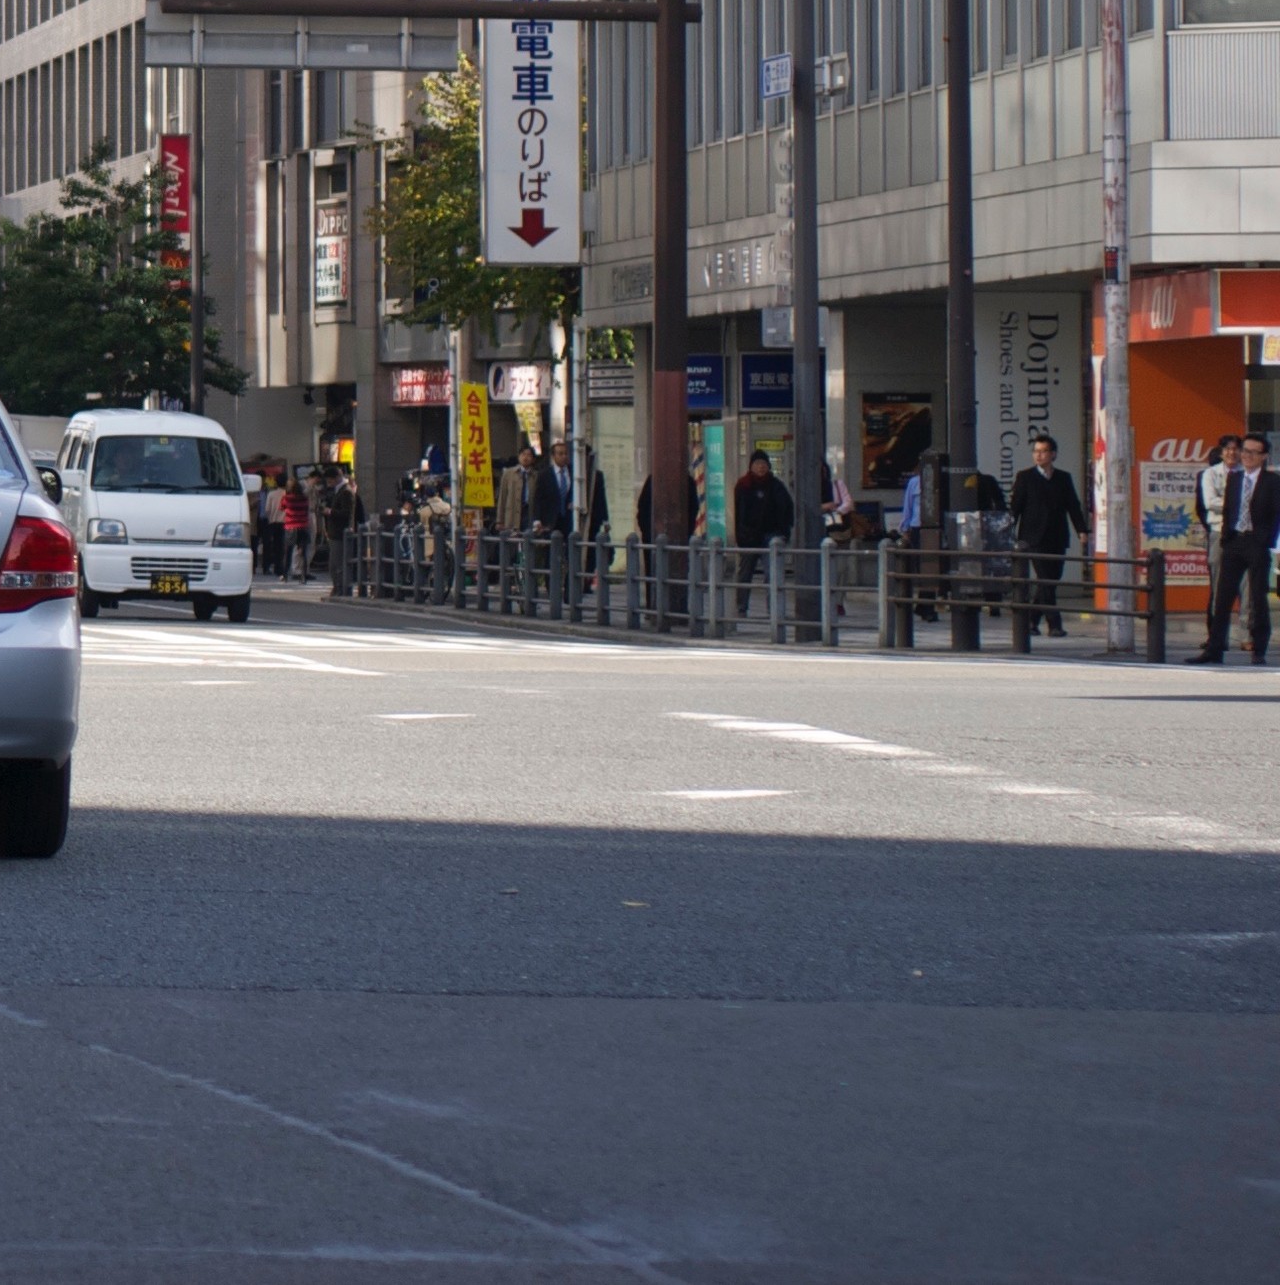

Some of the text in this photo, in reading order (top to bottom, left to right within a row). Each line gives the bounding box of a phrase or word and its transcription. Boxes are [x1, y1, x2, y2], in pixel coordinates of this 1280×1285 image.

[1150, 284, 1177, 330] au
[1000, 311, 1018, 376] Shoes
[1000, 383, 1019, 423] and
[1021, 313, 1060, 444] Dojima
[466, 390, 488, 473] 合カギ
[1151, 438, 1211, 462] au
